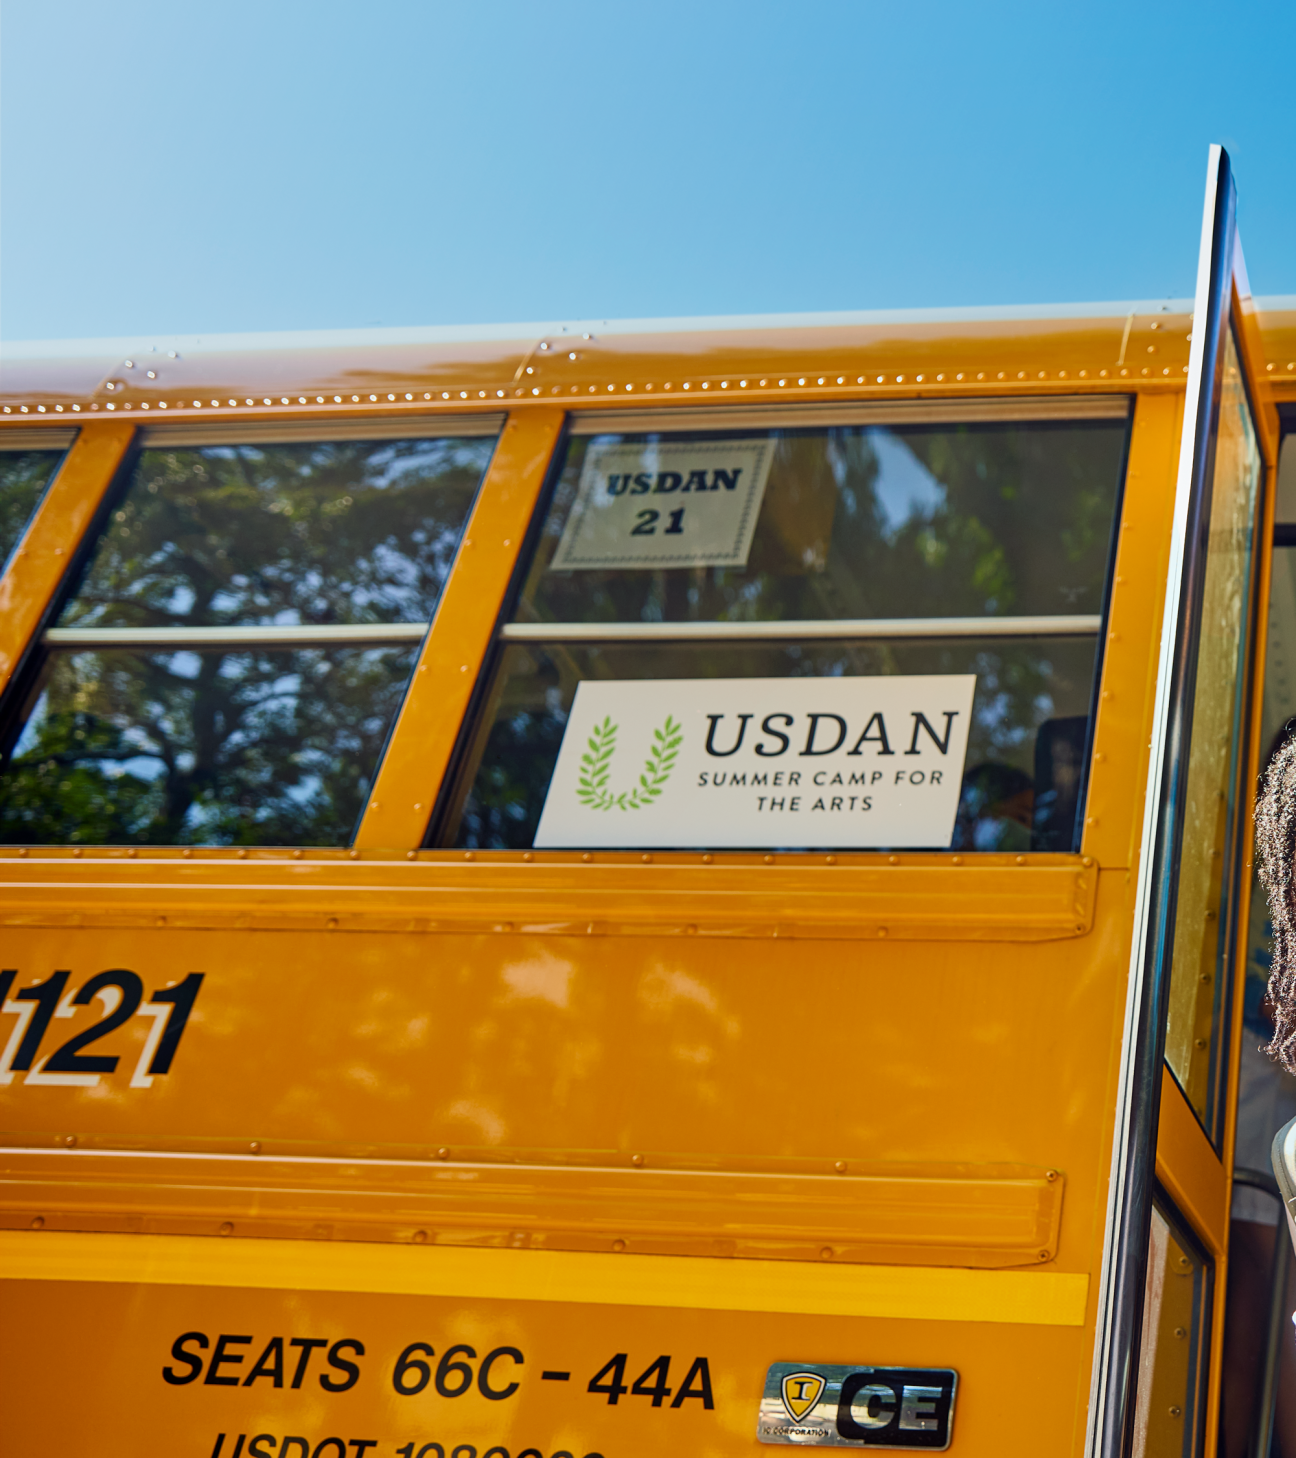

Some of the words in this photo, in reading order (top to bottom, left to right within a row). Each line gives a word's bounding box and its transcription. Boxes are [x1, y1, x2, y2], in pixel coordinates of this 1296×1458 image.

[606, 468, 742, 496] USDAN
[630, 507, 687, 536] 21
[704, 711, 960, 757] USDAN
[697, 771, 802, 788] SUMMER
[812, 770, 884, 787] CAMP
[893, 769, 944, 786] FOR
[756, 797, 803, 812] THE
[811, 796, 874, 812] ARTS
[0, 969, 206, 1087] 121
[162, 1331, 366, 1393] SEATS
[391, 1342, 526, 1400] 66C
[586, 1352, 716, 1410] 44A
[850, 1383, 943, 1431] CE
